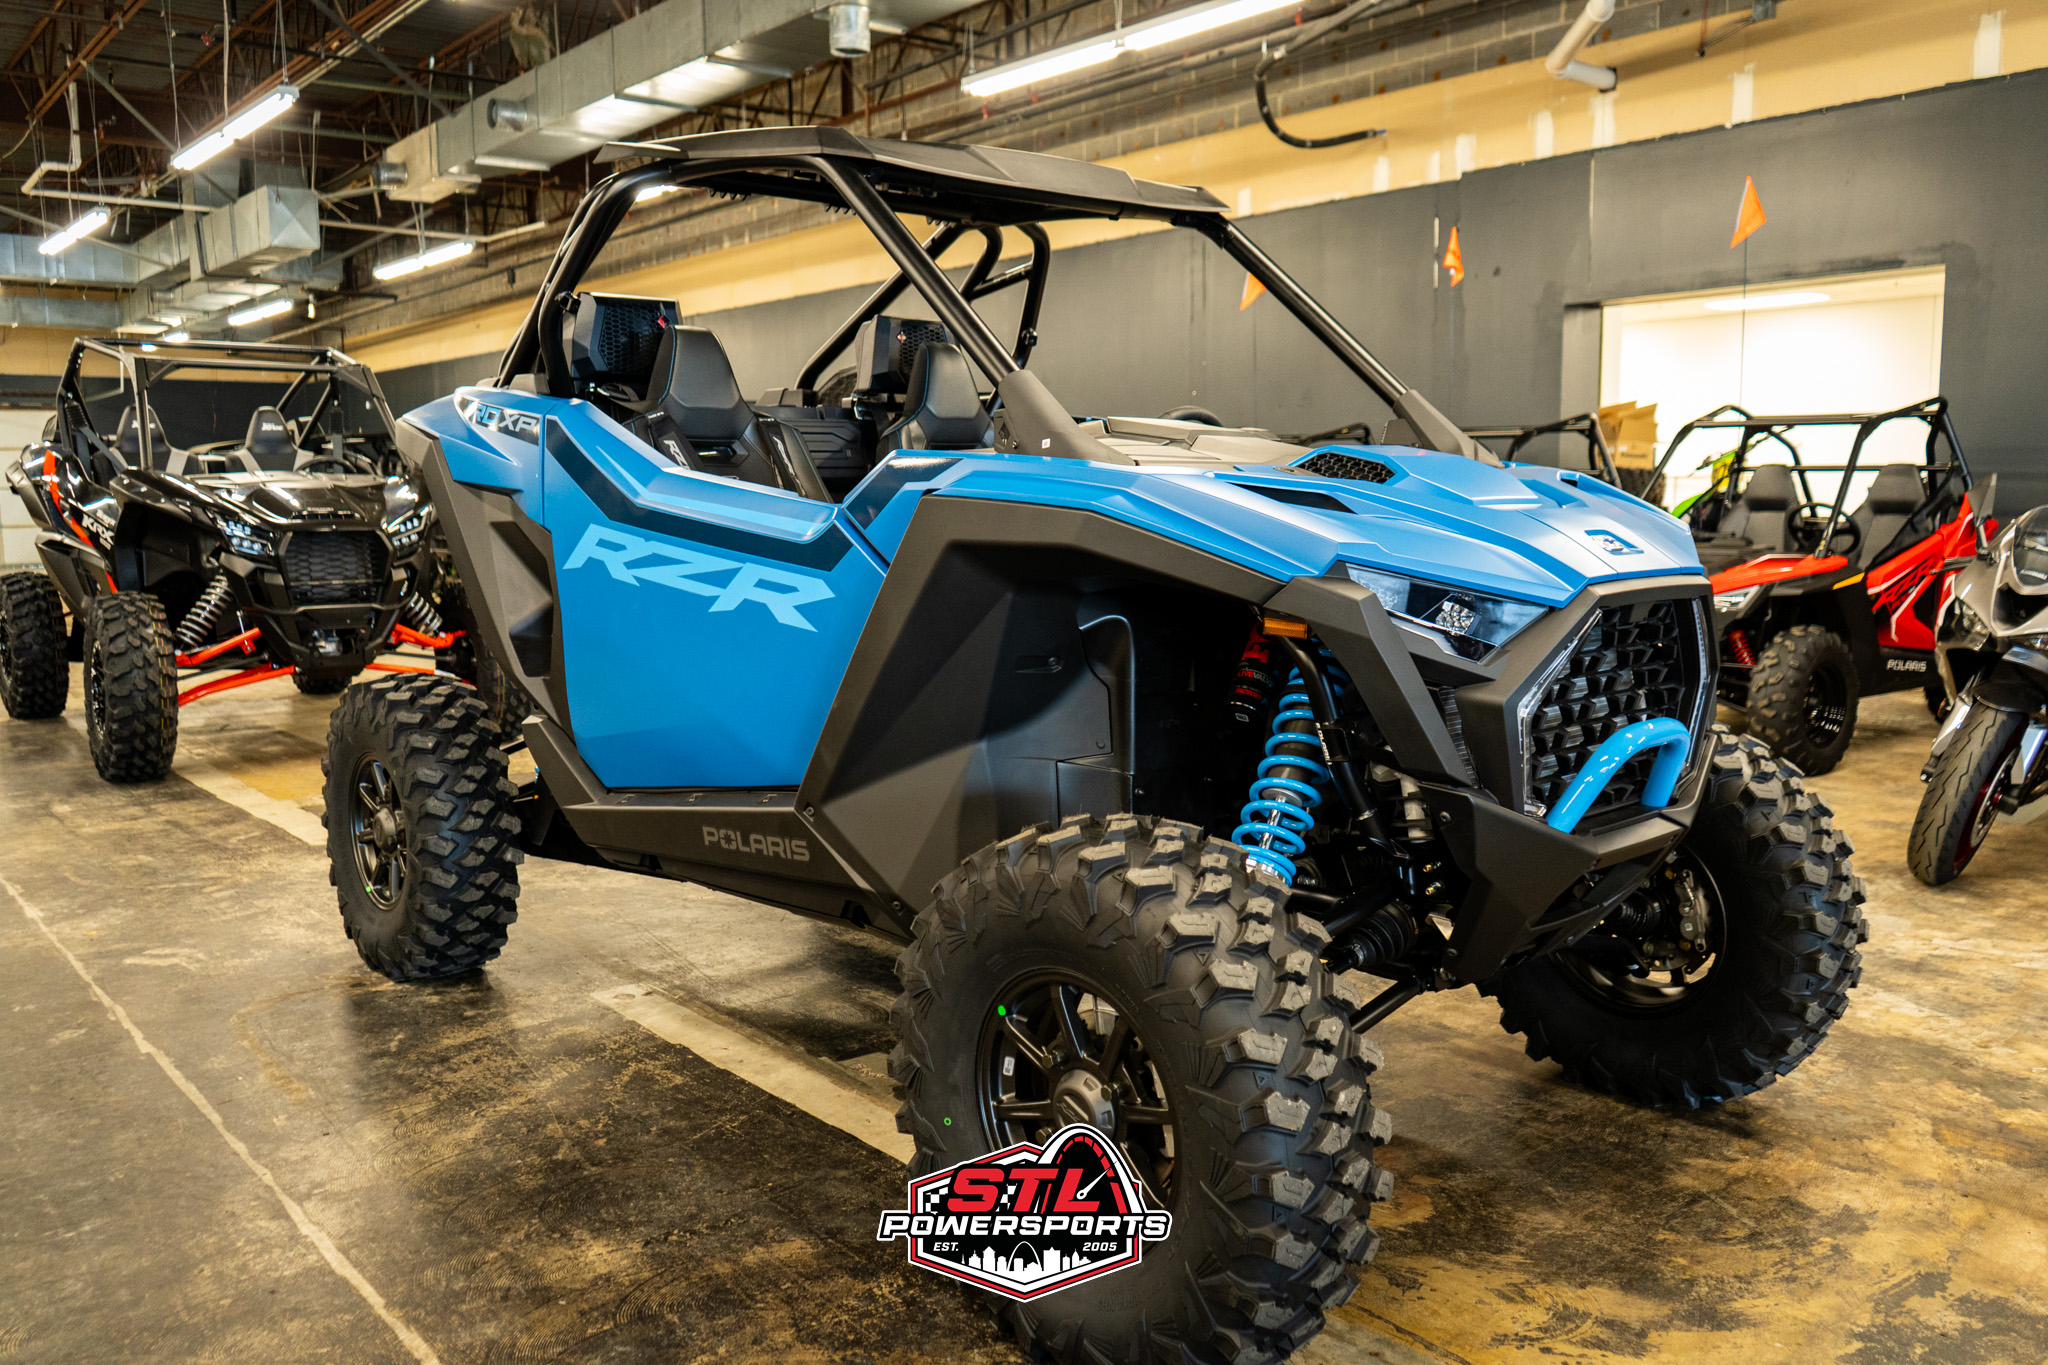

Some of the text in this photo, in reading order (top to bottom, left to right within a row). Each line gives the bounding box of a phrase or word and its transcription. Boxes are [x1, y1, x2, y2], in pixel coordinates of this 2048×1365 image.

[562, 523, 836, 632] RZR
[1886, 659, 1927, 672] POLARIS
[702, 826, 810, 861] POLARIS
